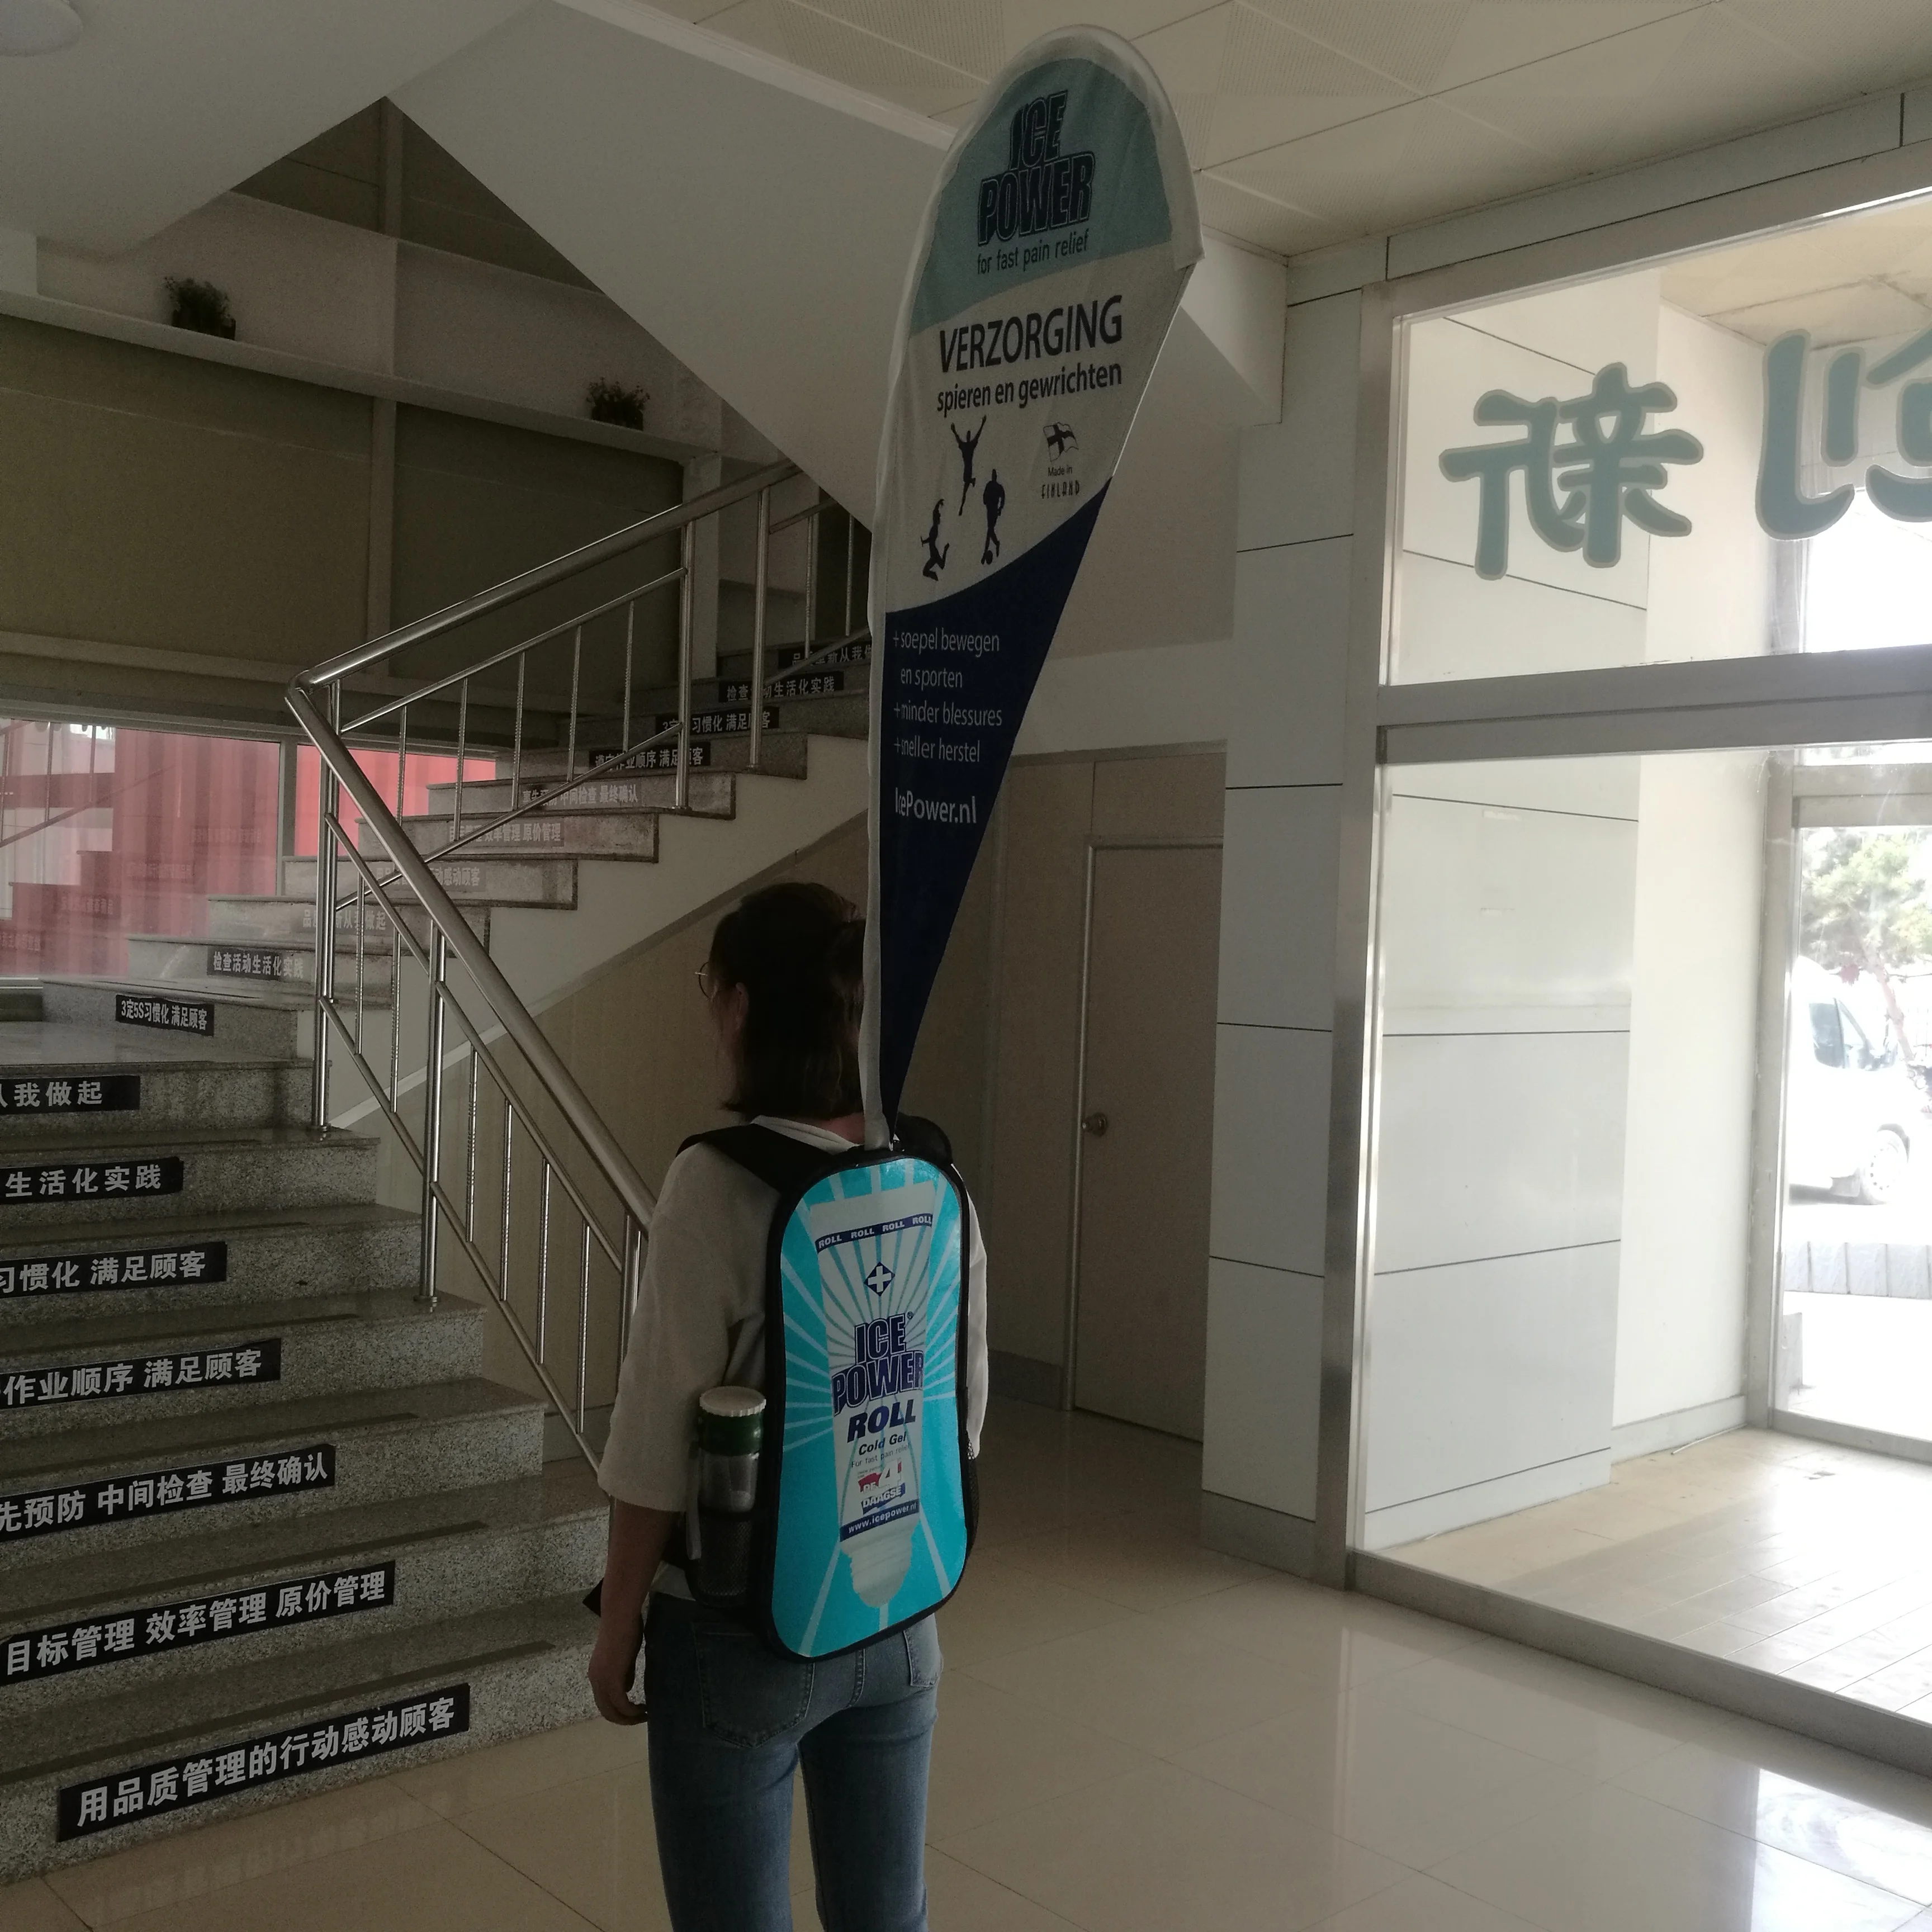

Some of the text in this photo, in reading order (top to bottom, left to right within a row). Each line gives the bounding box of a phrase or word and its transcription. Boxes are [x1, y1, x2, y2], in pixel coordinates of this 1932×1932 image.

[1010, 90, 1068, 169] ICE
[977, 151, 1095, 246] POWER
[977, 228, 1089, 274] for fast pain relief
[940, 295, 1122, 373] VERZORGING
[937, 363, 1121, 418] spieren en gewrichten
[1048, 465, 1072, 476] Made in
[1041, 480, 1079, 499] FINLAND
[941, 627, 1000, 658] bewegen
[901, 667, 963, 692] en sporten
[943, 701, 1002, 726] blessures
[939, 737, 980, 762] herstel
[600, 784, 638, 803] 最终确认
[523, 822, 561, 842] 原价管理
[214, 951, 303, 979] 检查活动生活化实践
[121, 998, 207, 1030] 3定5S习惯化 满足顾客
[5, 1164, 161, 1197] 生活化实践
[818, 1215, 932, 1249] ROLL ROLL ROLL ROLL
[90, 1251, 206, 1285] 满足顾客
[855, 1313, 906, 1365] ICE
[3, 1349, 262, 1405] 作业顺序 满足顾客
[831, 1350, 924, 1417] POWER
[847, 1399, 916, 1443] ROLL
[851, 1460, 862, 1468] For
[865, 1455, 878, 1464] fast
[880, 1450, 893, 1460] pain
[859, 1431, 906, 1455] Cold Gel
[0, 1452, 328, 1533] 先预防 中间检查 最终确认
[863, 1485, 902, 1508] DAAGSE
[849, 1502, 917, 1534] www.icepower.nl
[7, 1570, 385, 1676] 目标管理 效率管理 原价管理
[77, 1697, 454, 1827] 用品质管理的行动感动顾客
